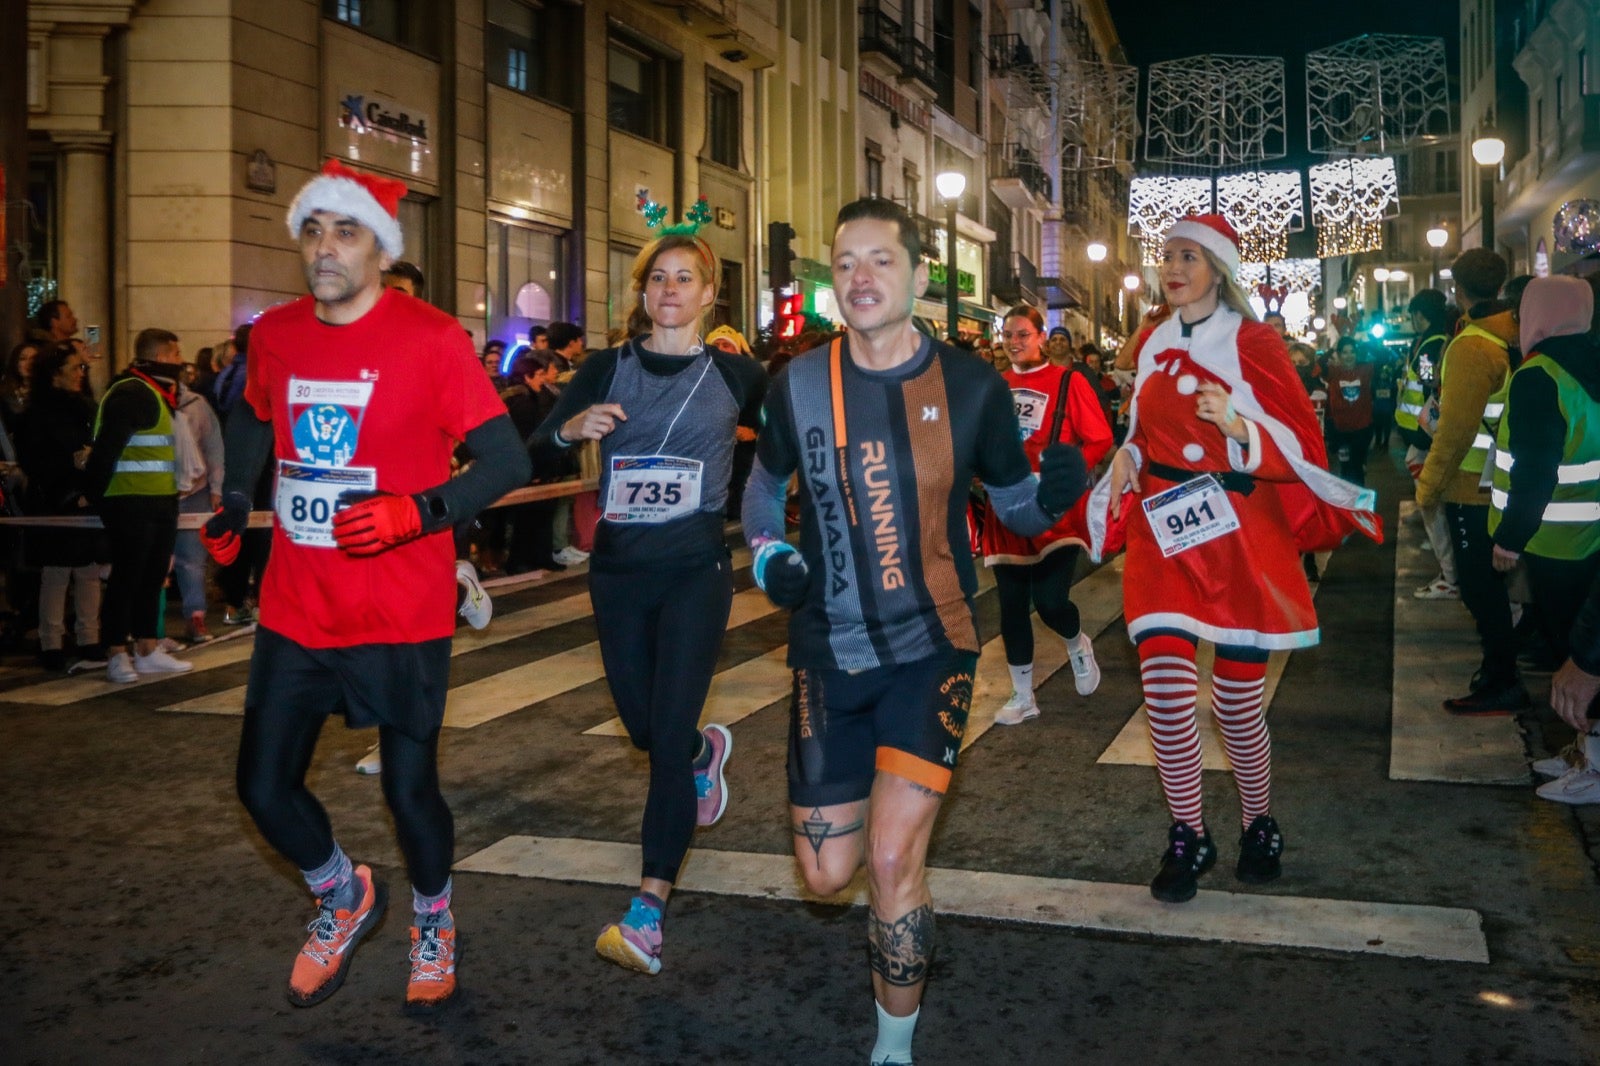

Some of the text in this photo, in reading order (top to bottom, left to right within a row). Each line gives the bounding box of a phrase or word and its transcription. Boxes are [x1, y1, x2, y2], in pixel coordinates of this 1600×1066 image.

[295, 385, 311, 398] 30
[626, 481, 682, 506] 735
[806, 425, 849, 598] GRANADA
[860, 440, 906, 591] RUNNING
[1166, 500, 1216, 535] 941
[940, 672, 973, 694] GRAN
